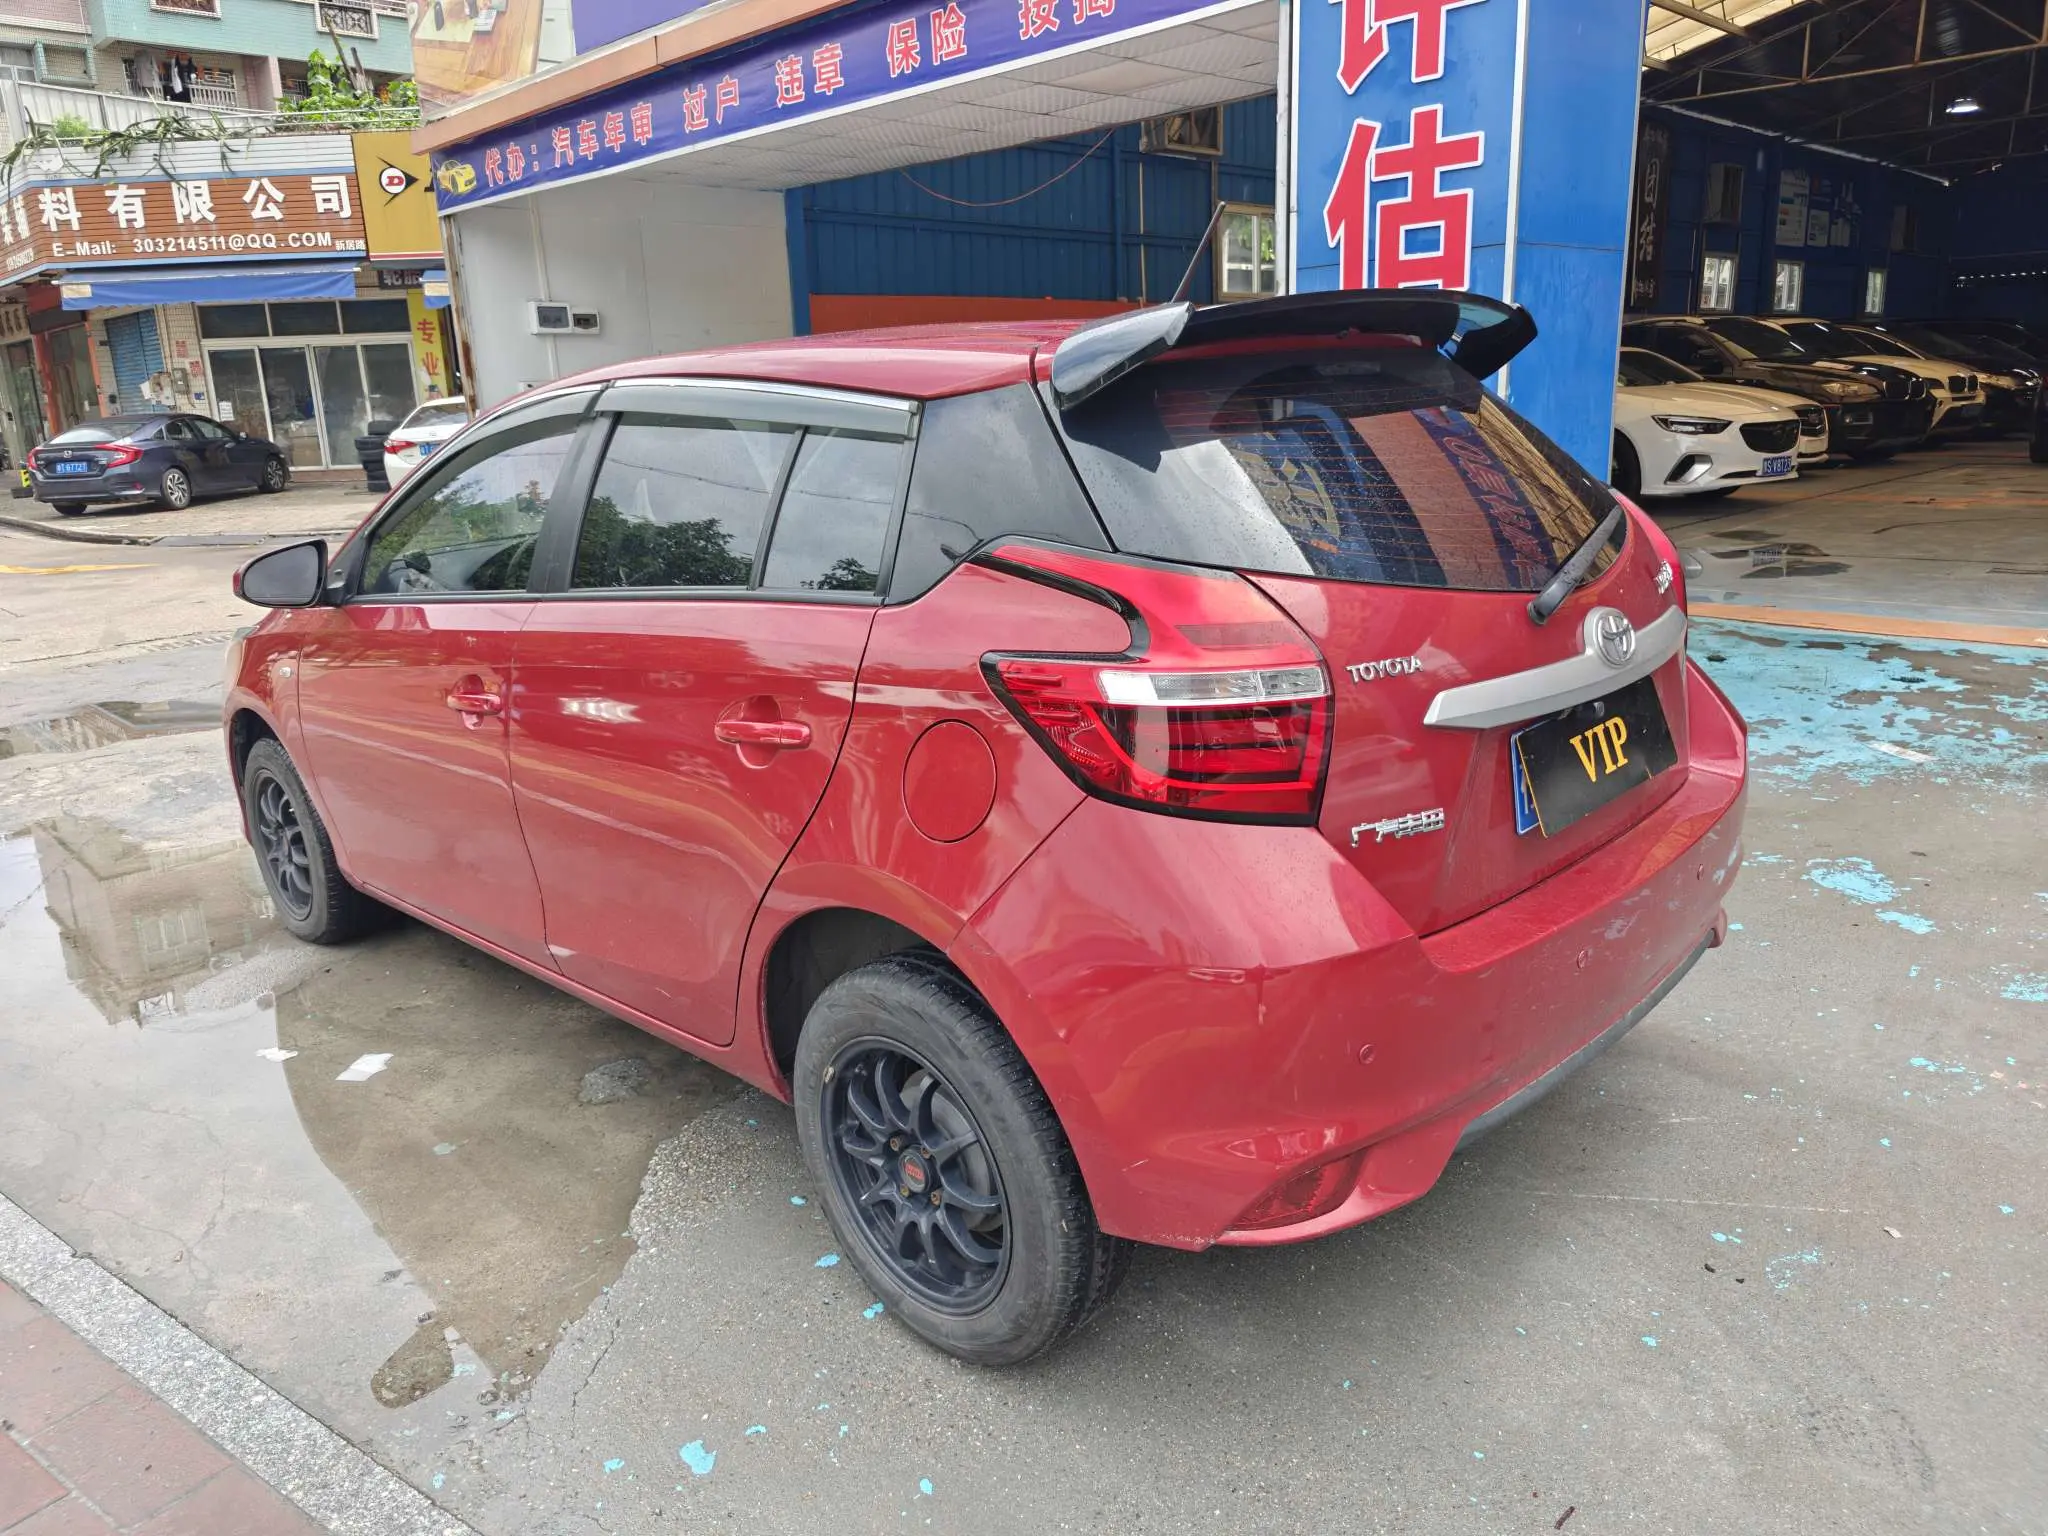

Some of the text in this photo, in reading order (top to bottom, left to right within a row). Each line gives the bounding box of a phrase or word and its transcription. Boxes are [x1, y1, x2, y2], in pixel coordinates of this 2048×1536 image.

[682, 74, 740, 134] 过户
[775, 42, 845, 108] 违章
[886, 2, 967, 78] 保险
[1346, 655, 1424, 684] TOYOTA
[1568, 716, 1629, 784] VIP
